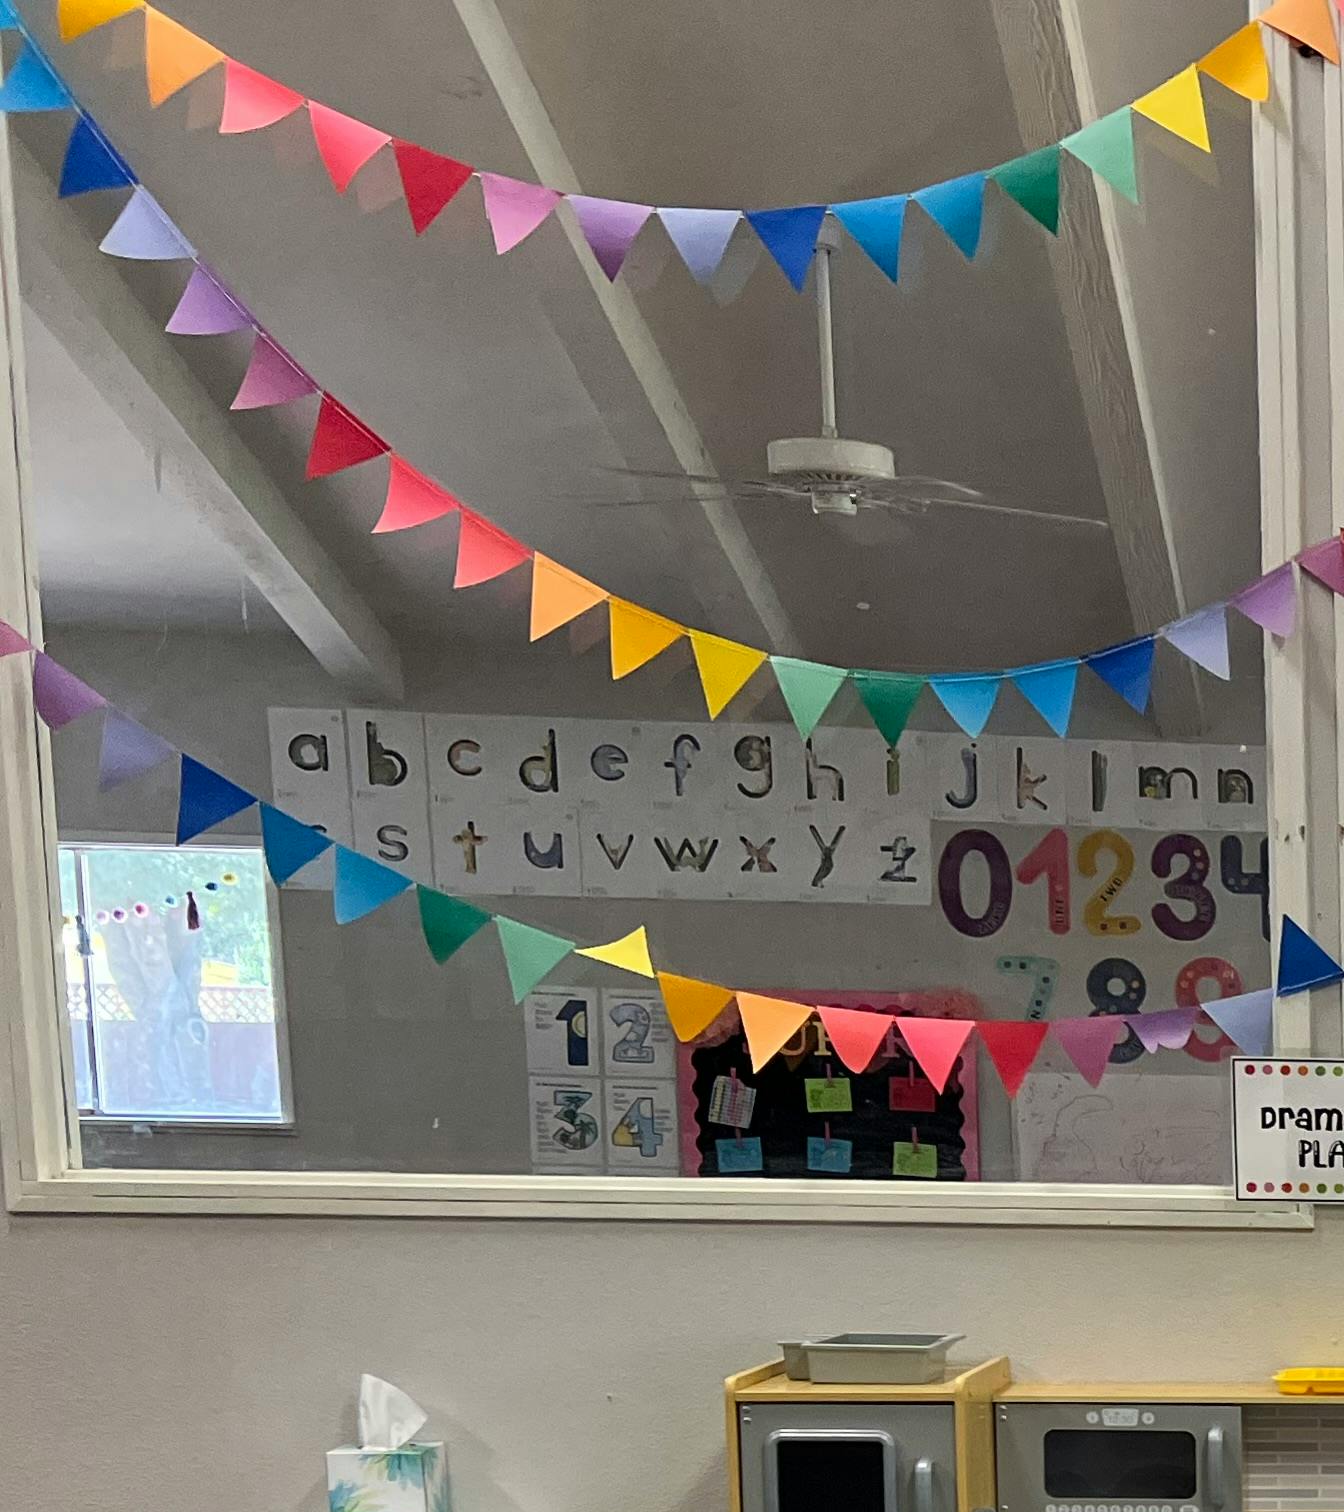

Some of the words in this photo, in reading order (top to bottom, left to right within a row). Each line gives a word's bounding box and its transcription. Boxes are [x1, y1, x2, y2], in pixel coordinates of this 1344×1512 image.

[288, 733, 328, 772] a
[365, 721, 408, 786] b
[447, 739, 483, 776] c
[518, 728, 560, 793] d
[590, 743, 629, 781] e
[663, 733, 701, 797] f
[734, 734, 773, 799] g
[805, 734, 845, 801] h
[945, 742, 979, 809] j
[1016, 746, 1048, 811] k
[1138, 764, 1198, 801] m
[1217, 767, 1254, 804] n
[377, 825, 410, 862] s
[452, 820, 488, 874] t
[522, 830, 563, 869] u
[596, 833, 634, 870] v
[653, 836, 719, 873] w
[738, 836, 778, 873] x
[809, 825, 846, 888] y
[938, 829, 1012, 938] 0
[1016, 828, 1071, 935] 1
[1077, 830, 1141, 936] 2
[1151, 833, 1216, 941] 3
[555, 1000, 589, 1066] 1
[609, 1003, 655, 1063] 2
[1086, 957, 1147, 1064] 8
[552, 1090, 598, 1150] 3
[611, 1097, 663, 1158] 4
